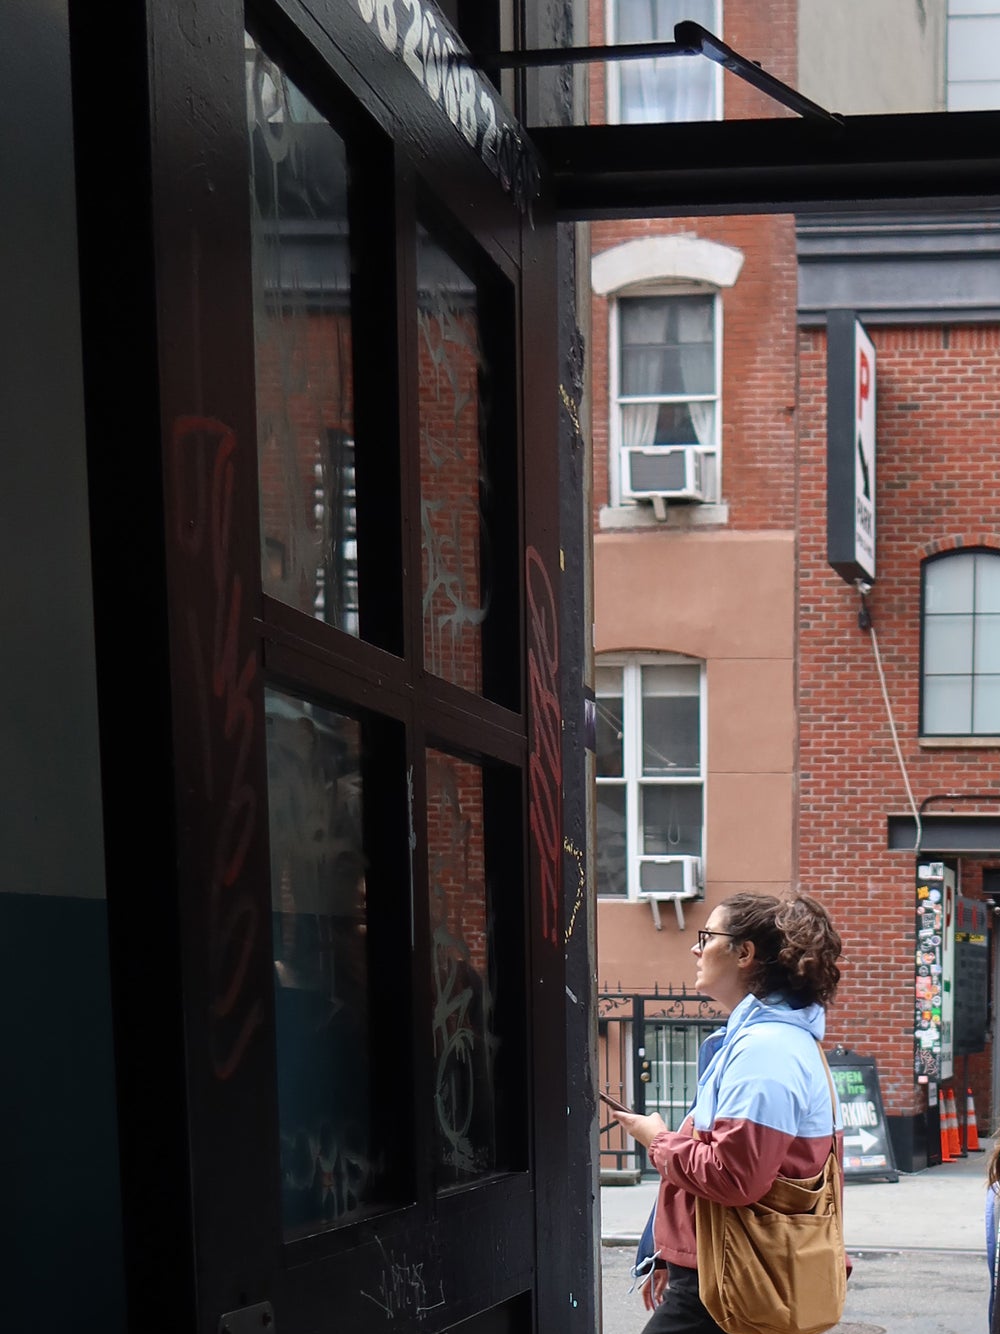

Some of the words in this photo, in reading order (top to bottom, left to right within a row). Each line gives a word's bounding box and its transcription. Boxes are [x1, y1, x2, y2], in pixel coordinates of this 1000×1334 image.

[859, 348, 870, 421] P
[847, 1084, 866, 1095] hrs
[841, 1100, 878, 1127] RKING
